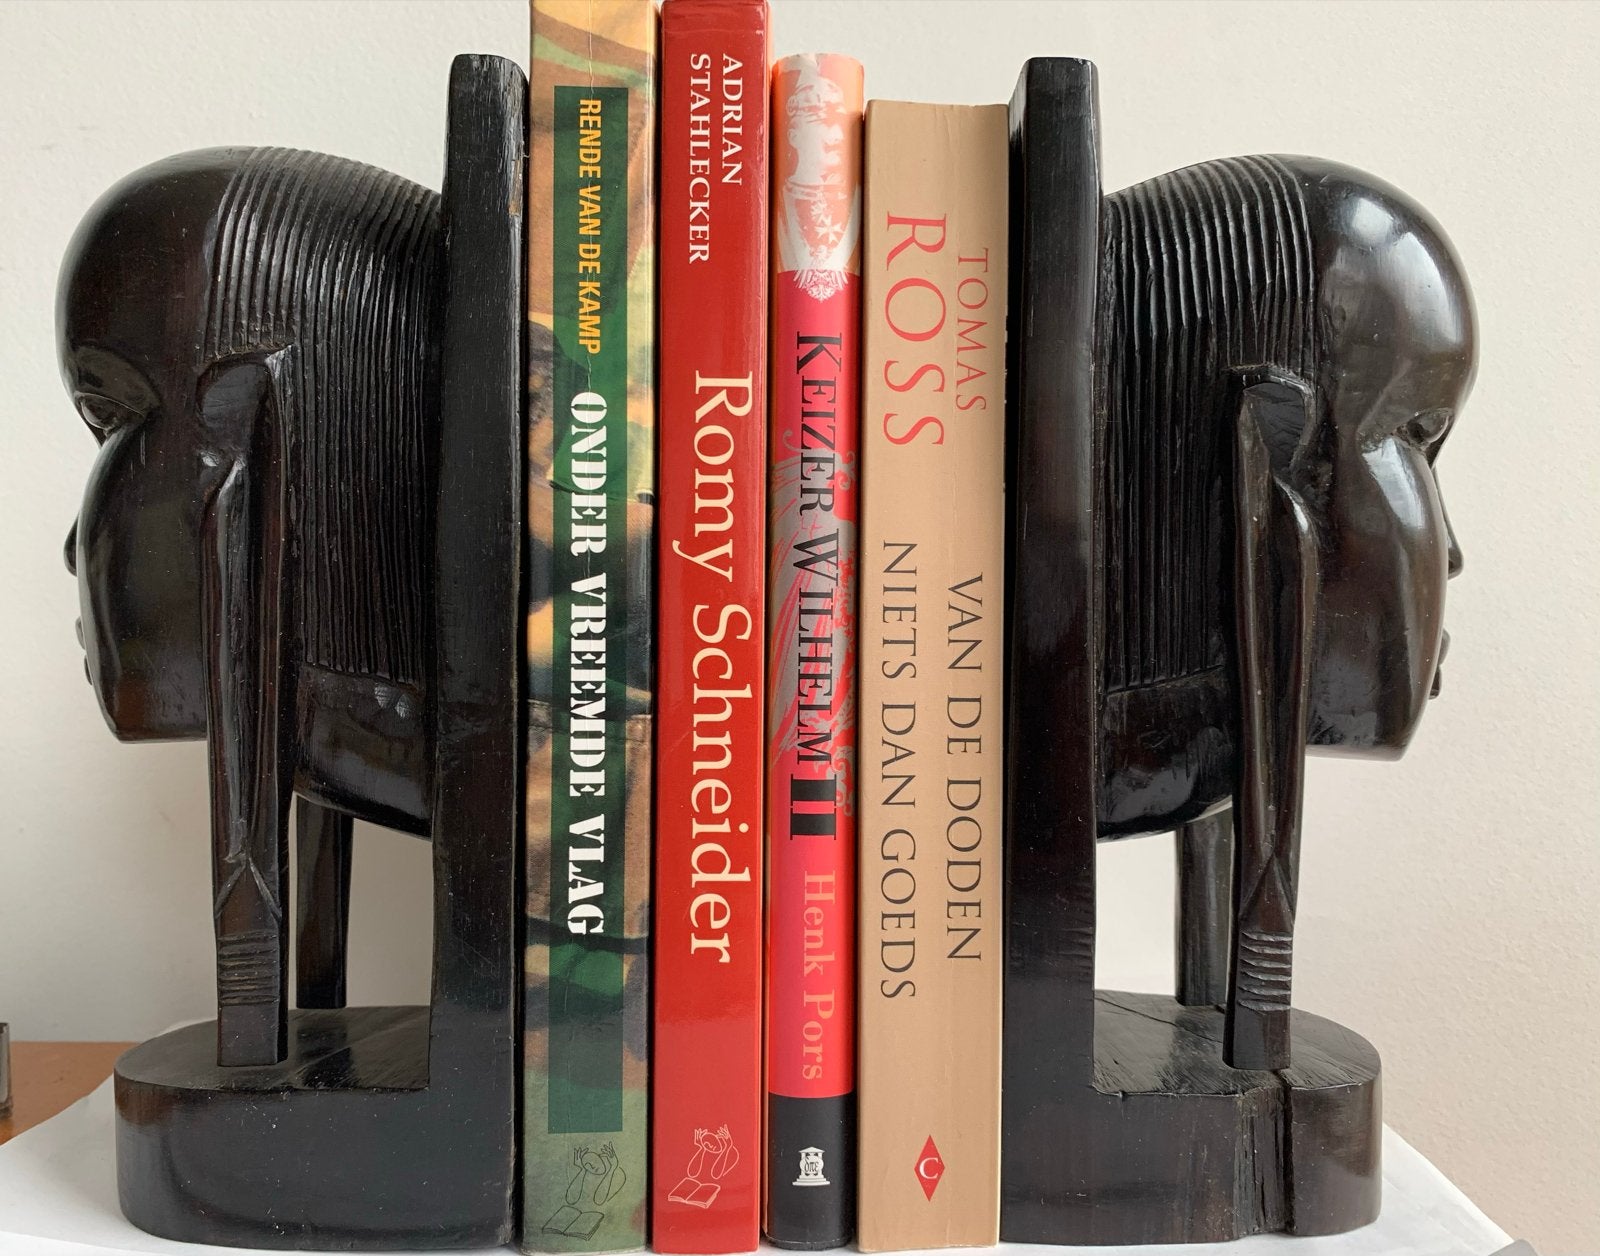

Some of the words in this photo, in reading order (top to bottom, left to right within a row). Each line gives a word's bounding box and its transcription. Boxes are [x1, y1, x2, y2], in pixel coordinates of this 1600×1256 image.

[579, 99, 602, 179] RENDE
[688, 53, 711, 264] STAHLECKER
[721, 53, 744, 185] ADRIAN
[578, 186, 602, 236] VAN
[578, 243, 601, 274] DE
[578, 281, 601, 354] KAMP
[883, 211, 947, 446] ROSS
[955, 247, 989, 411] TOMAS
[570, 391, 607, 557] ONDER
[672, 370, 754, 583] Romy
[796, 331, 842, 517] KEIZER
[793, 528, 840, 765] WILHELM
[881, 540, 918, 680] NIETS
[947, 574, 983, 672] VAN
[569, 572, 607, 797] VREEMDE
[946, 696, 983, 755] DE
[689, 603, 753, 964] Schneider
[790, 773, 837, 841] II
[881, 702, 917, 808] DAN
[567, 813, 605, 936] VLAG
[803, 870, 836, 976] Henk
[880, 829, 917, 999] GOEDS
[945, 777, 983, 961] DODEN
[802, 990, 835, 1080] Pors
[919, 1157, 939, 1180] C
